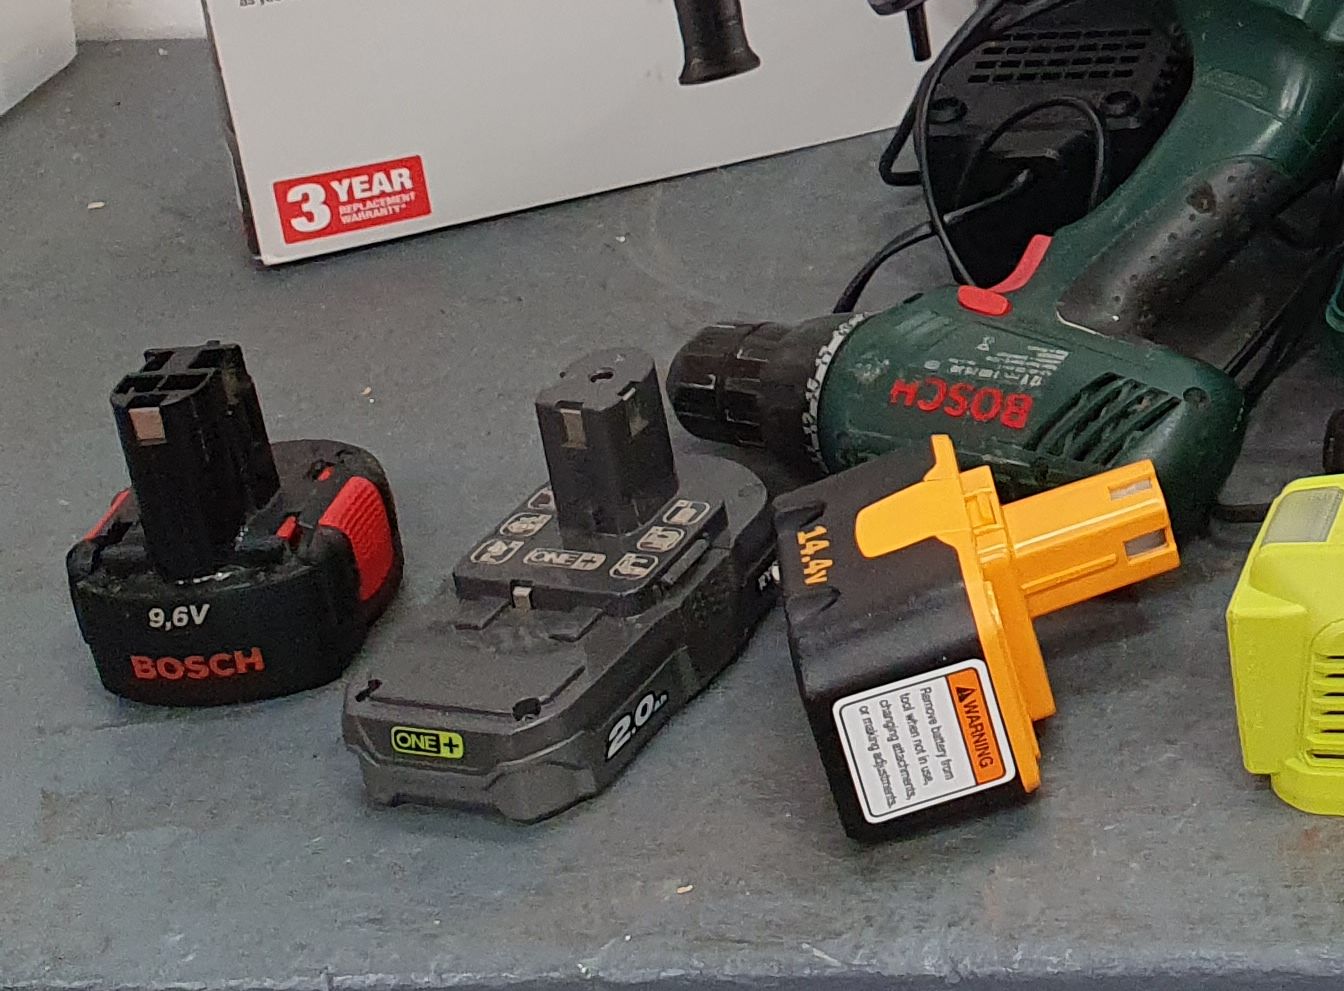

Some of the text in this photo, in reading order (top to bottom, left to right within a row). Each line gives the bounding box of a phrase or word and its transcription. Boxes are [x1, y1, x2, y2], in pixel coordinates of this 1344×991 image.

[286, 167, 413, 232] 3 YEAR
[340, 192, 416, 214] REPLACEMENT
[890, 377, 1034, 429] BOSCH
[148, 604, 210, 631] 9,6V
[130, 647, 265, 680] BOSCH
[859, 706, 869, 716] or
[879, 700, 899, 742] changing
[862, 714, 879, 752] making
[900, 693, 933, 785] tool when not in use,
[920, 687, 954, 780] Remove battery from
[964, 699, 993, 769] WARNING
